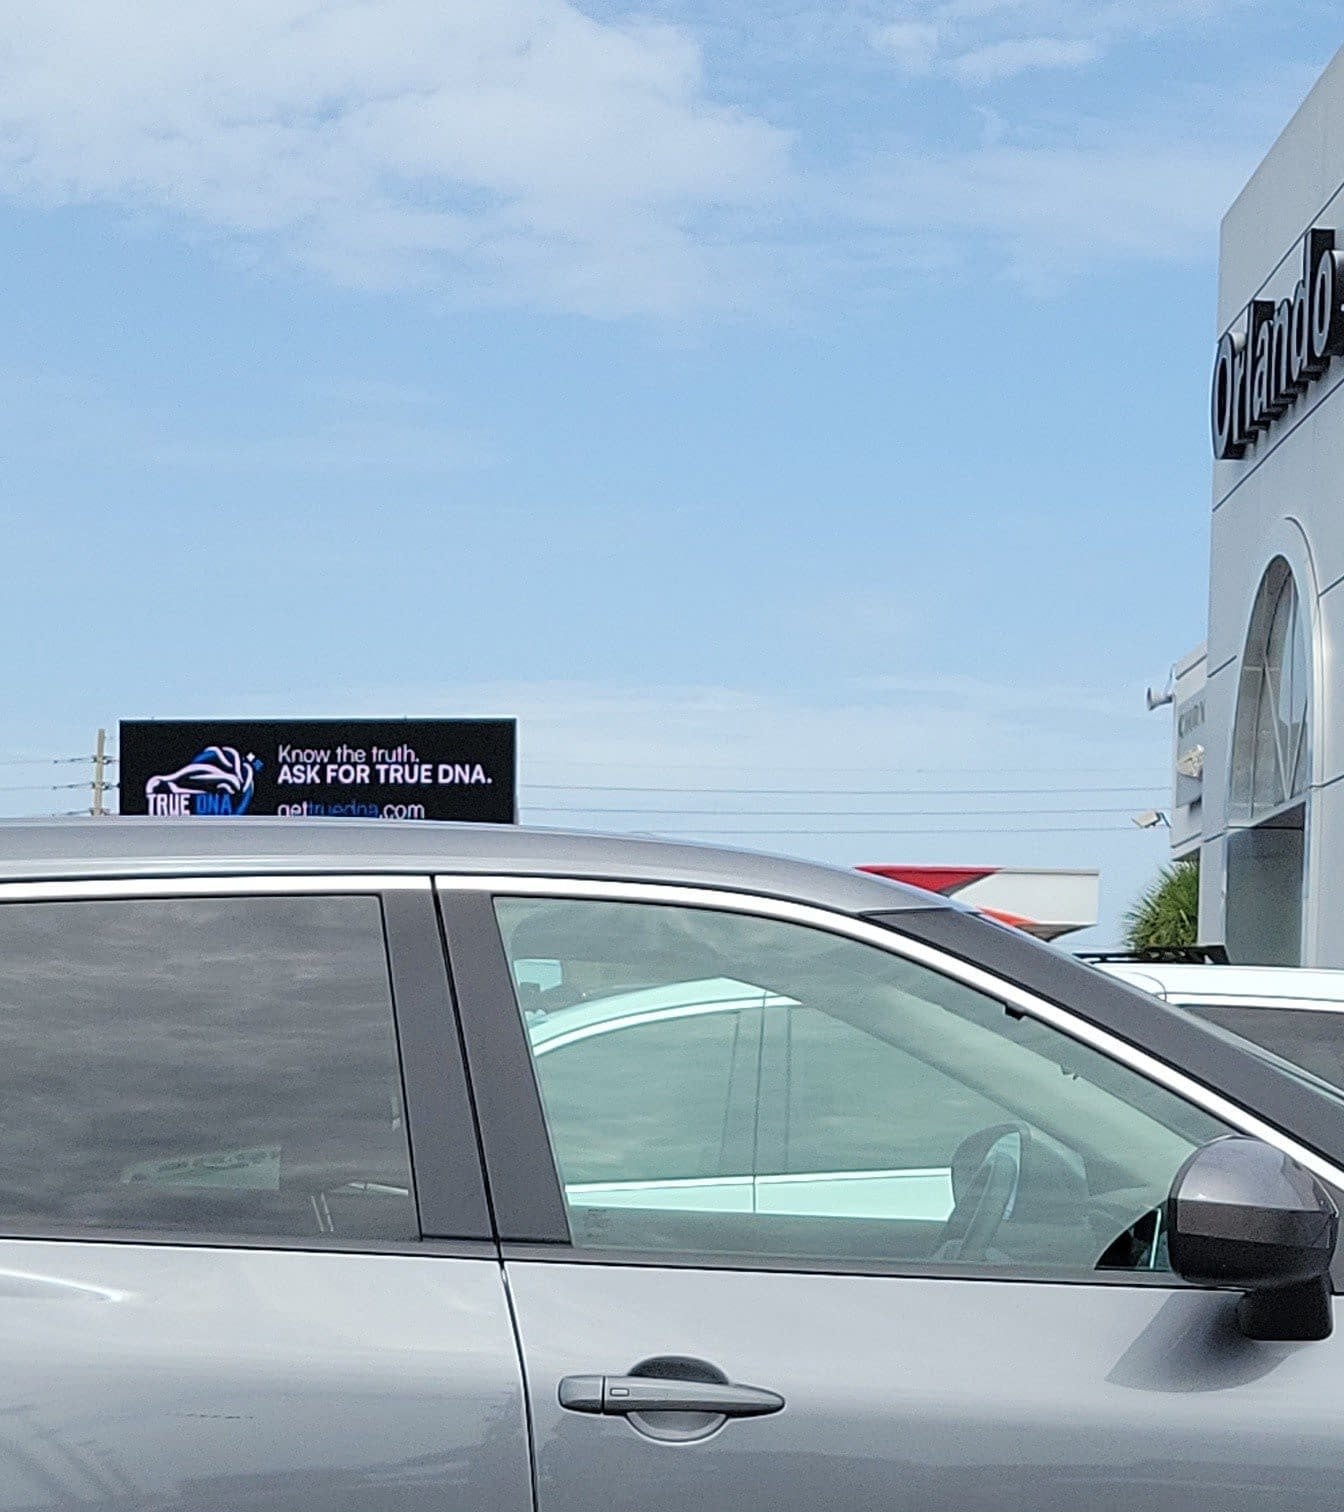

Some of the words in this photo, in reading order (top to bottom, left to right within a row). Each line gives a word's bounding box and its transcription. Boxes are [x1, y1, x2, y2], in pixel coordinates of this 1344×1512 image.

[278, 745, 331, 763] Know
[336, 744, 366, 763] the
[372, 744, 420, 763] truth.
[277, 764, 321, 784] ASK
[326, 764, 370, 784] FOR
[375, 764, 433, 784] TRUE
[438, 764, 493, 784] DNA.
[146, 793, 191, 816] TRUE
[197, 793, 232, 816] DNA
